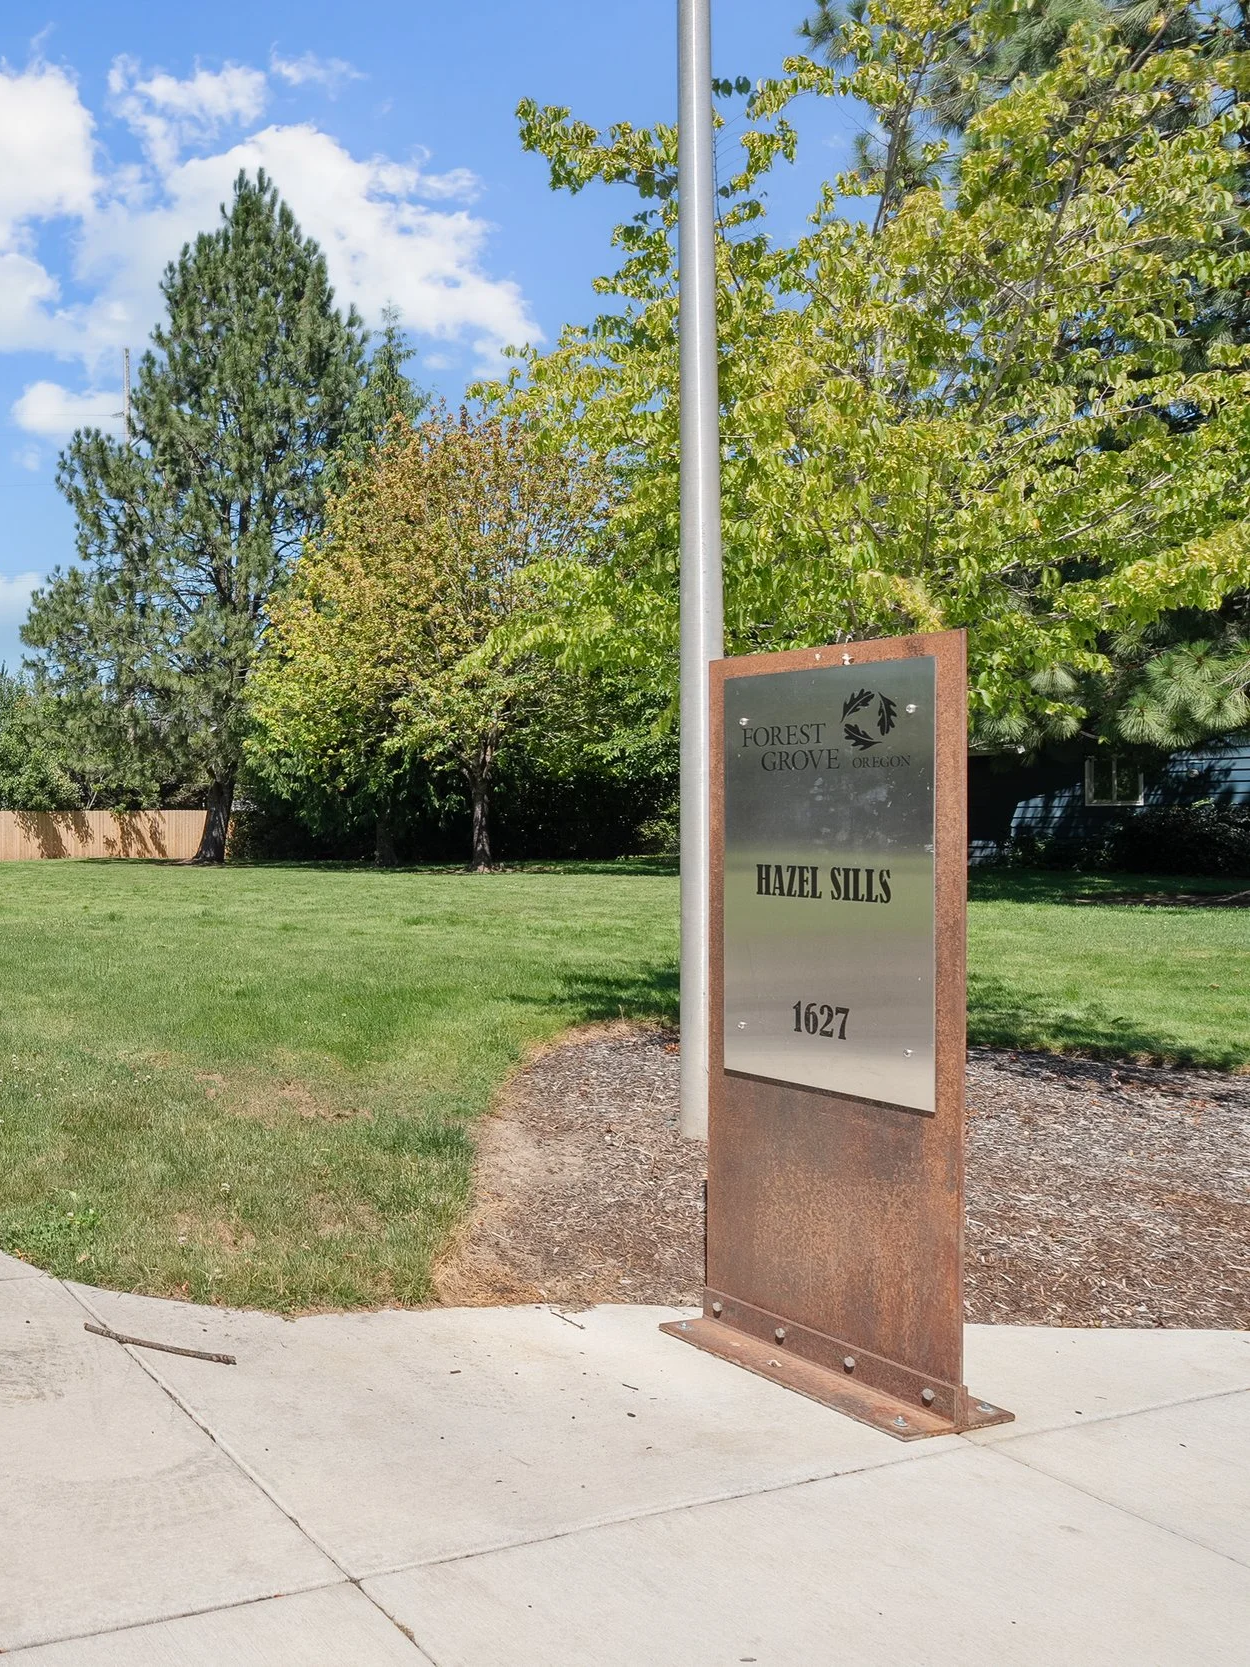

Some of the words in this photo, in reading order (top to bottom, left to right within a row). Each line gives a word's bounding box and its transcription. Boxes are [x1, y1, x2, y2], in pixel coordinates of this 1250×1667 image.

[741, 722, 826, 748] FOREST
[761, 748, 840, 772] GROVE
[852, 754, 911, 769] OREGON
[756, 863, 822, 899] HAZEL
[830, 866, 892, 904] SILLS
[792, 1000, 850, 1040] 1627
